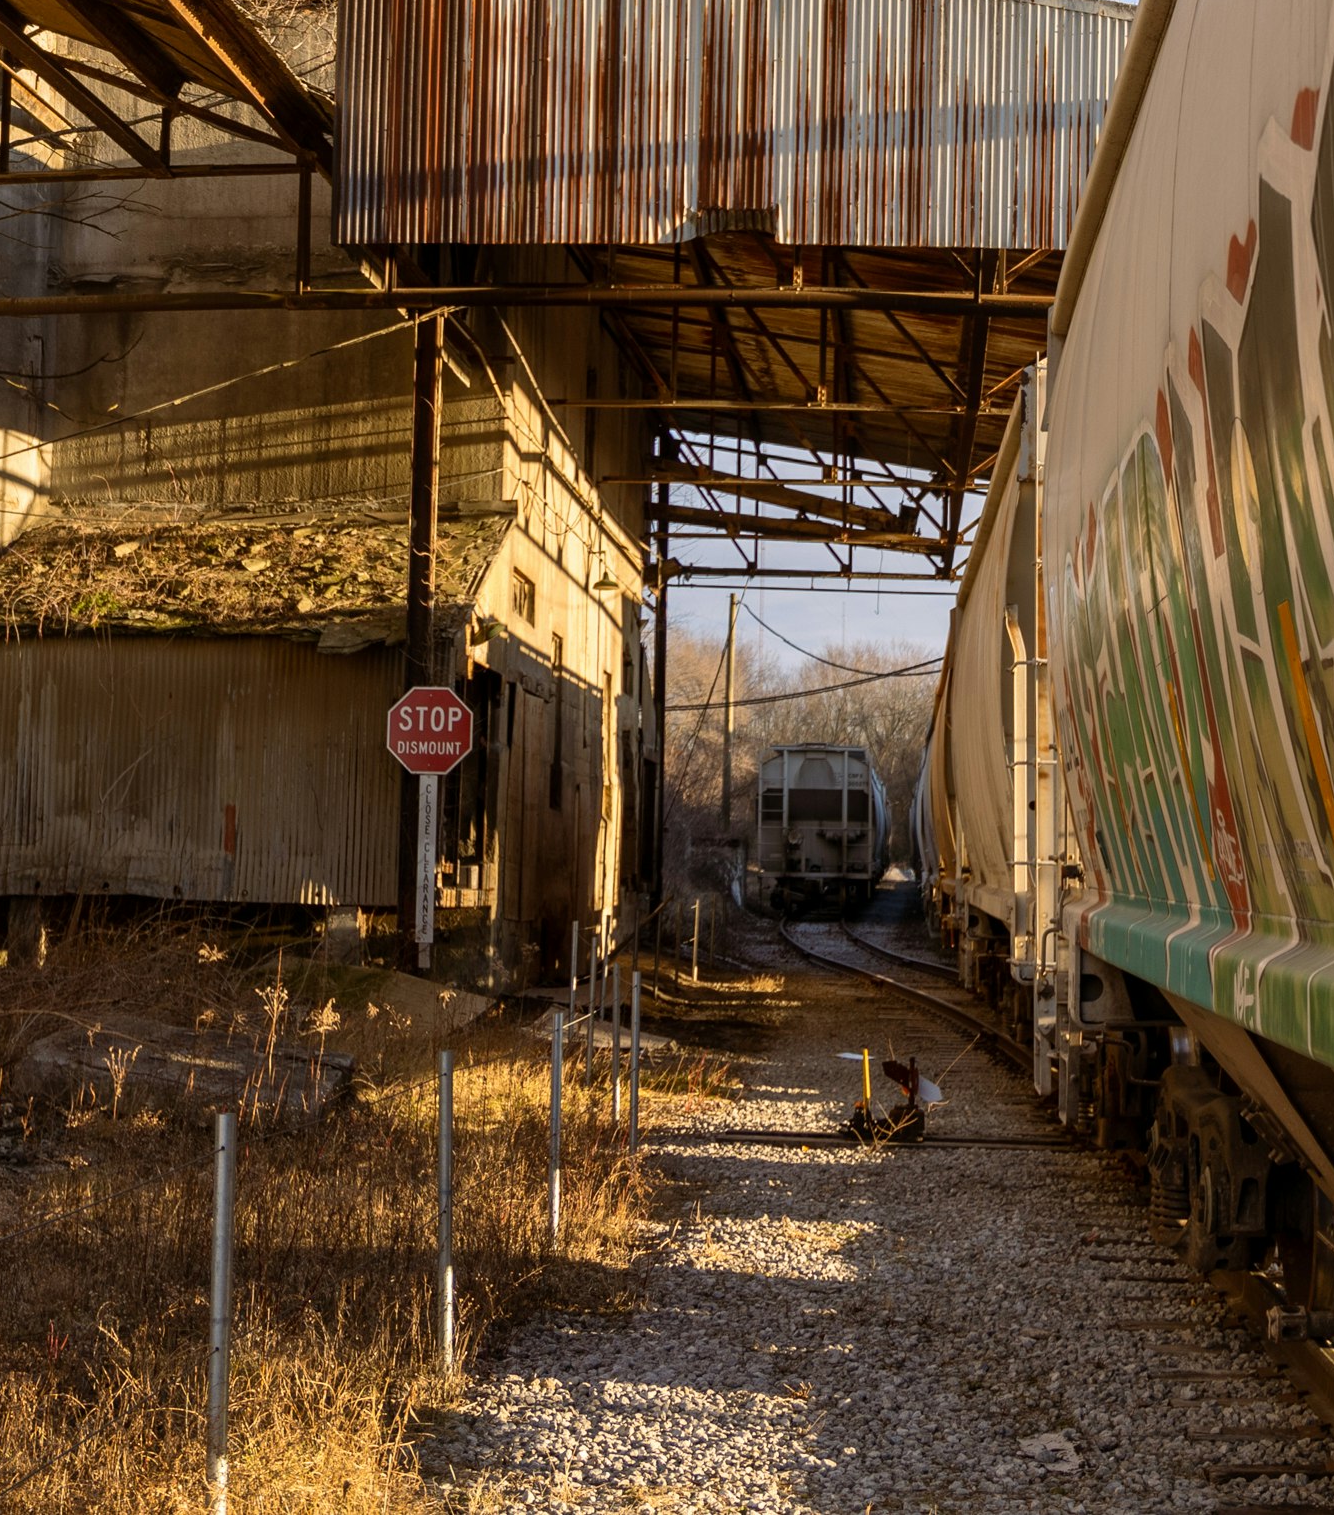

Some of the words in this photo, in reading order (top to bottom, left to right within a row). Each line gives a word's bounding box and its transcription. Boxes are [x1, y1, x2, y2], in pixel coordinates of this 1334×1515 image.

[399, 706, 462, 732] STOP
[397, 741, 461, 755] DISMOUNT
[422, 842, 430, 935] CLEARANCE
